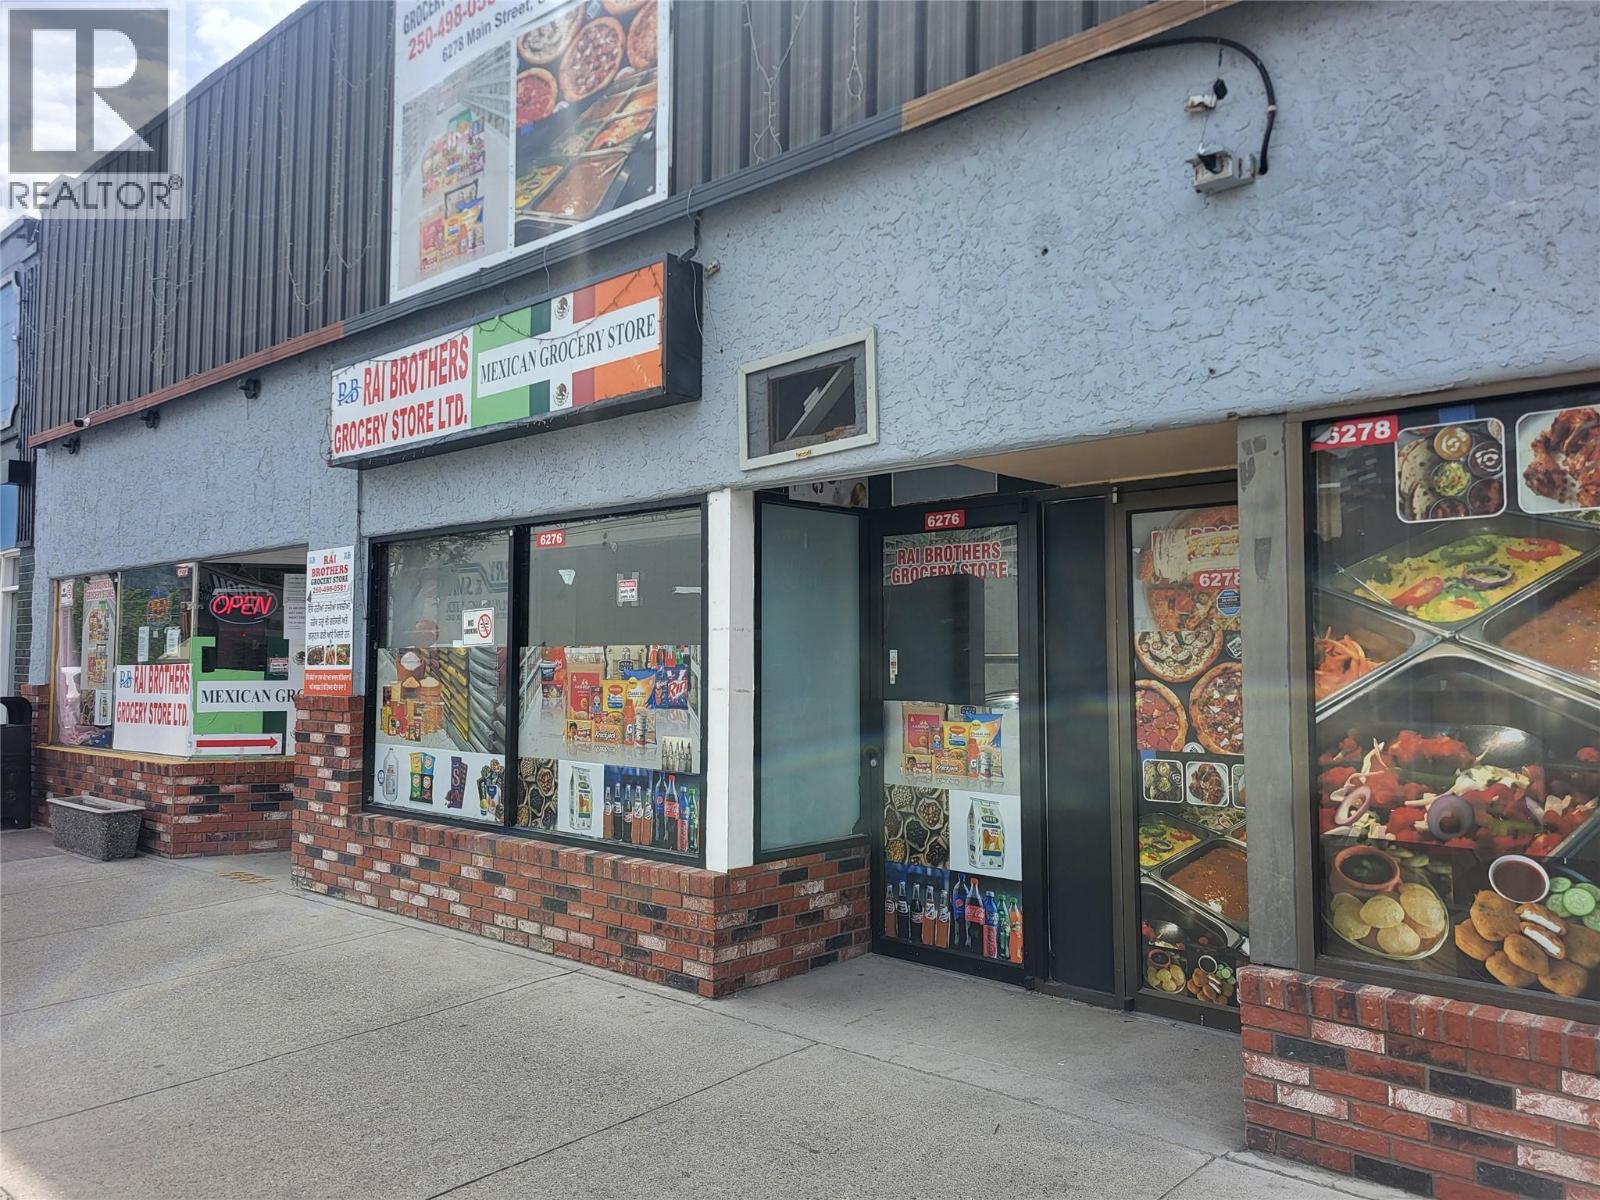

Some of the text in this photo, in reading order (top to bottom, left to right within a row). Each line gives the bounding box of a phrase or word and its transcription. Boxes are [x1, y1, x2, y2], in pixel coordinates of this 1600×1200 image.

[442, 1, 533, 62] 6278 Main Street,
[480, 313, 656, 385] MEXICAN GROCERY STORE
[363, 361, 385, 406] RAI
[389, 335, 469, 399] BROTHERS
[334, 393, 468, 454] GROCERY STORE LTD.
[927, 513, 960, 528] 6276
[540, 533, 562, 545] 6276
[324, 555, 336, 564] RAI
[896, 541, 1001, 565] RAI BROTHERS
[312, 565, 348, 577] BROTHERS
[212, 595, 273, 615] OPEN
[134, 665, 146, 694] RAI
[148, 664, 190, 695] BROTHERS
[201, 689, 271, 704] MEXICAN
[117, 701, 189, 727] GROCERY STORE LTD.
